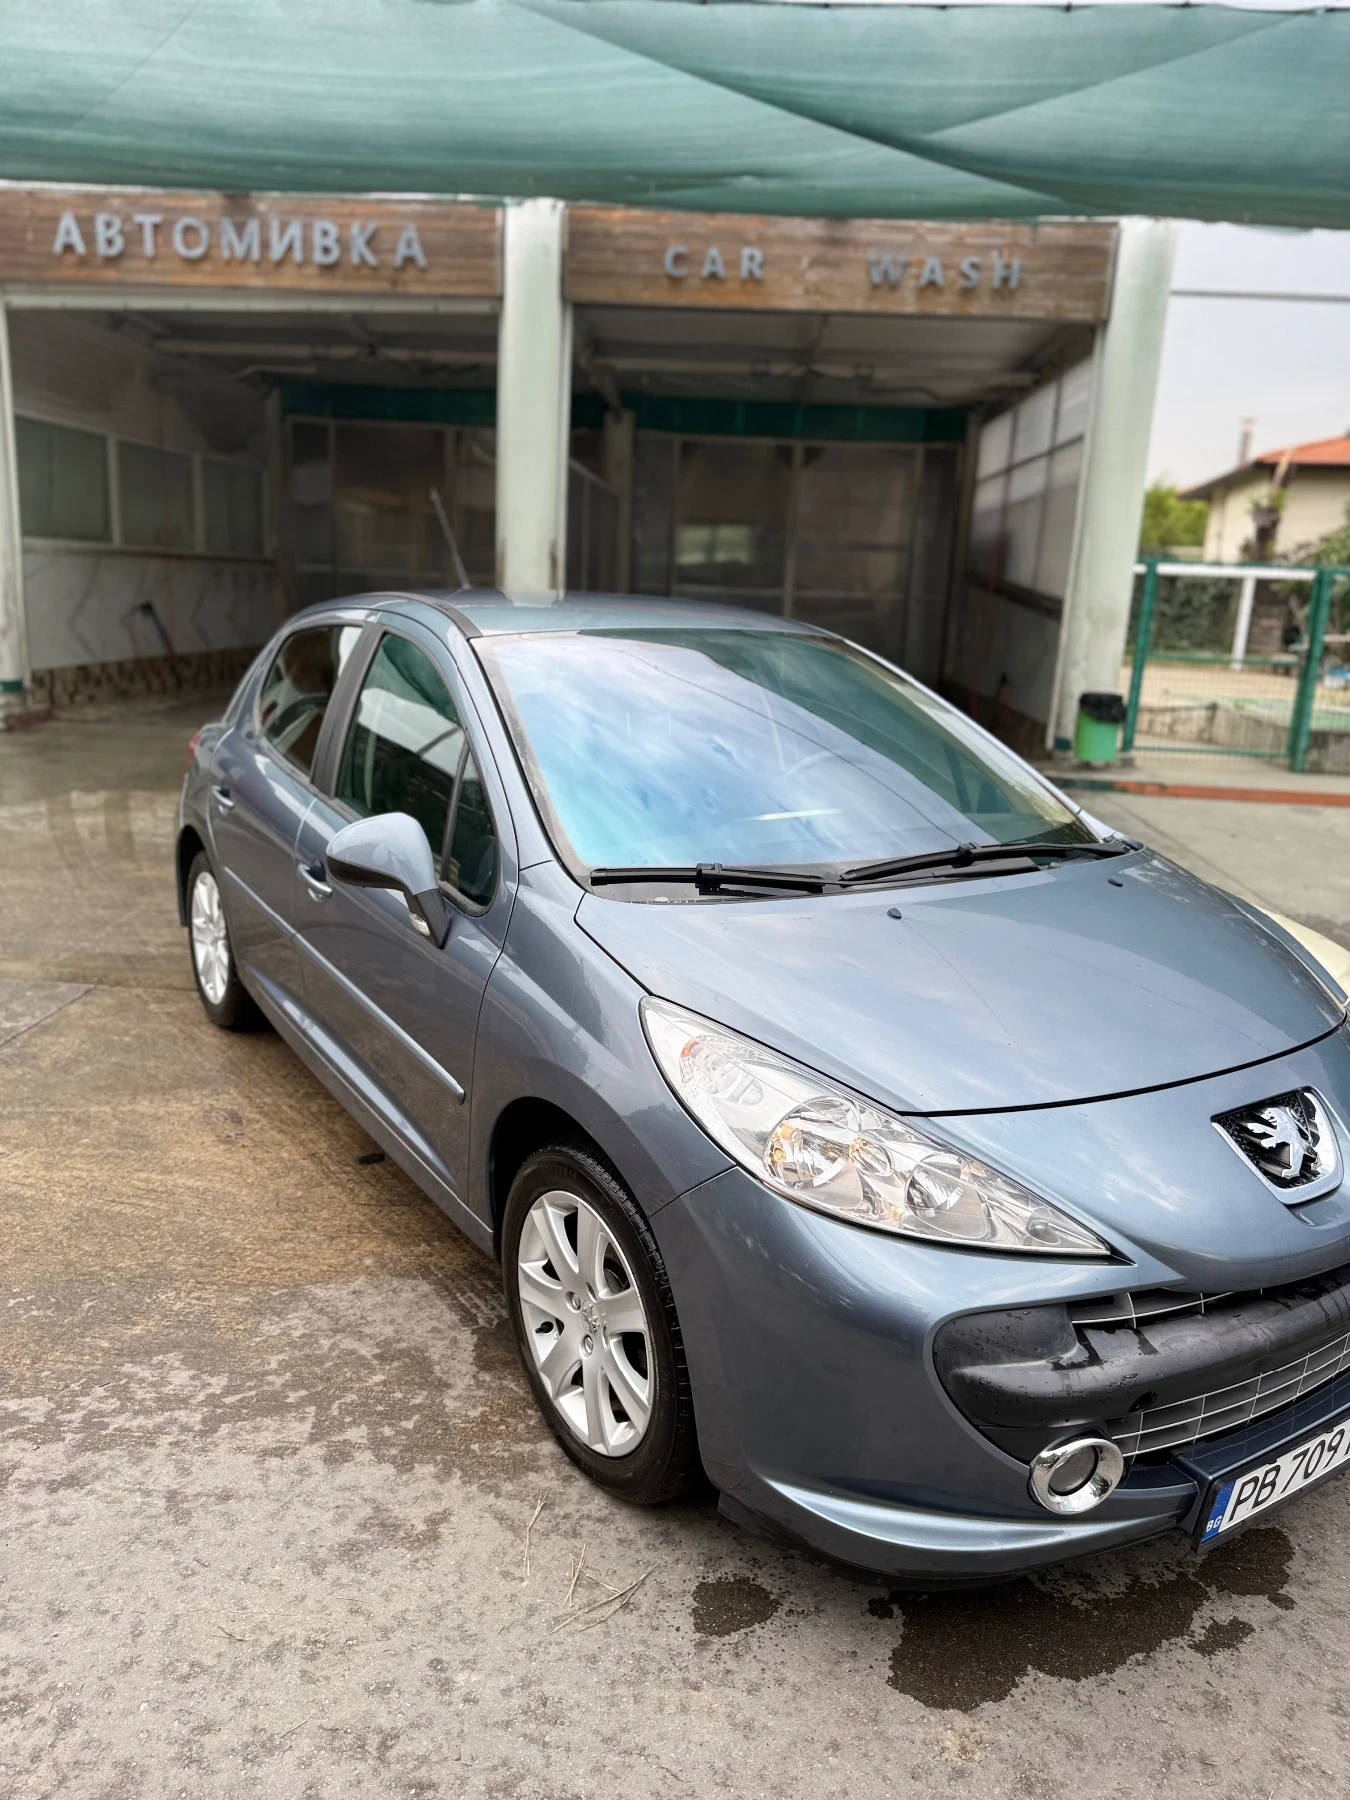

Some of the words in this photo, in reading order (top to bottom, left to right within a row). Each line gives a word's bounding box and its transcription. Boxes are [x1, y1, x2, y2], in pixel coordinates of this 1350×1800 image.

[52, 210, 428, 269] АВТОМИВКА
[663, 244, 765, 282] CAR
[868, 252, 1022, 291] WASH
[1280, 1427, 1350, 1495] 709
[1205, 1515, 1223, 1533] BG
